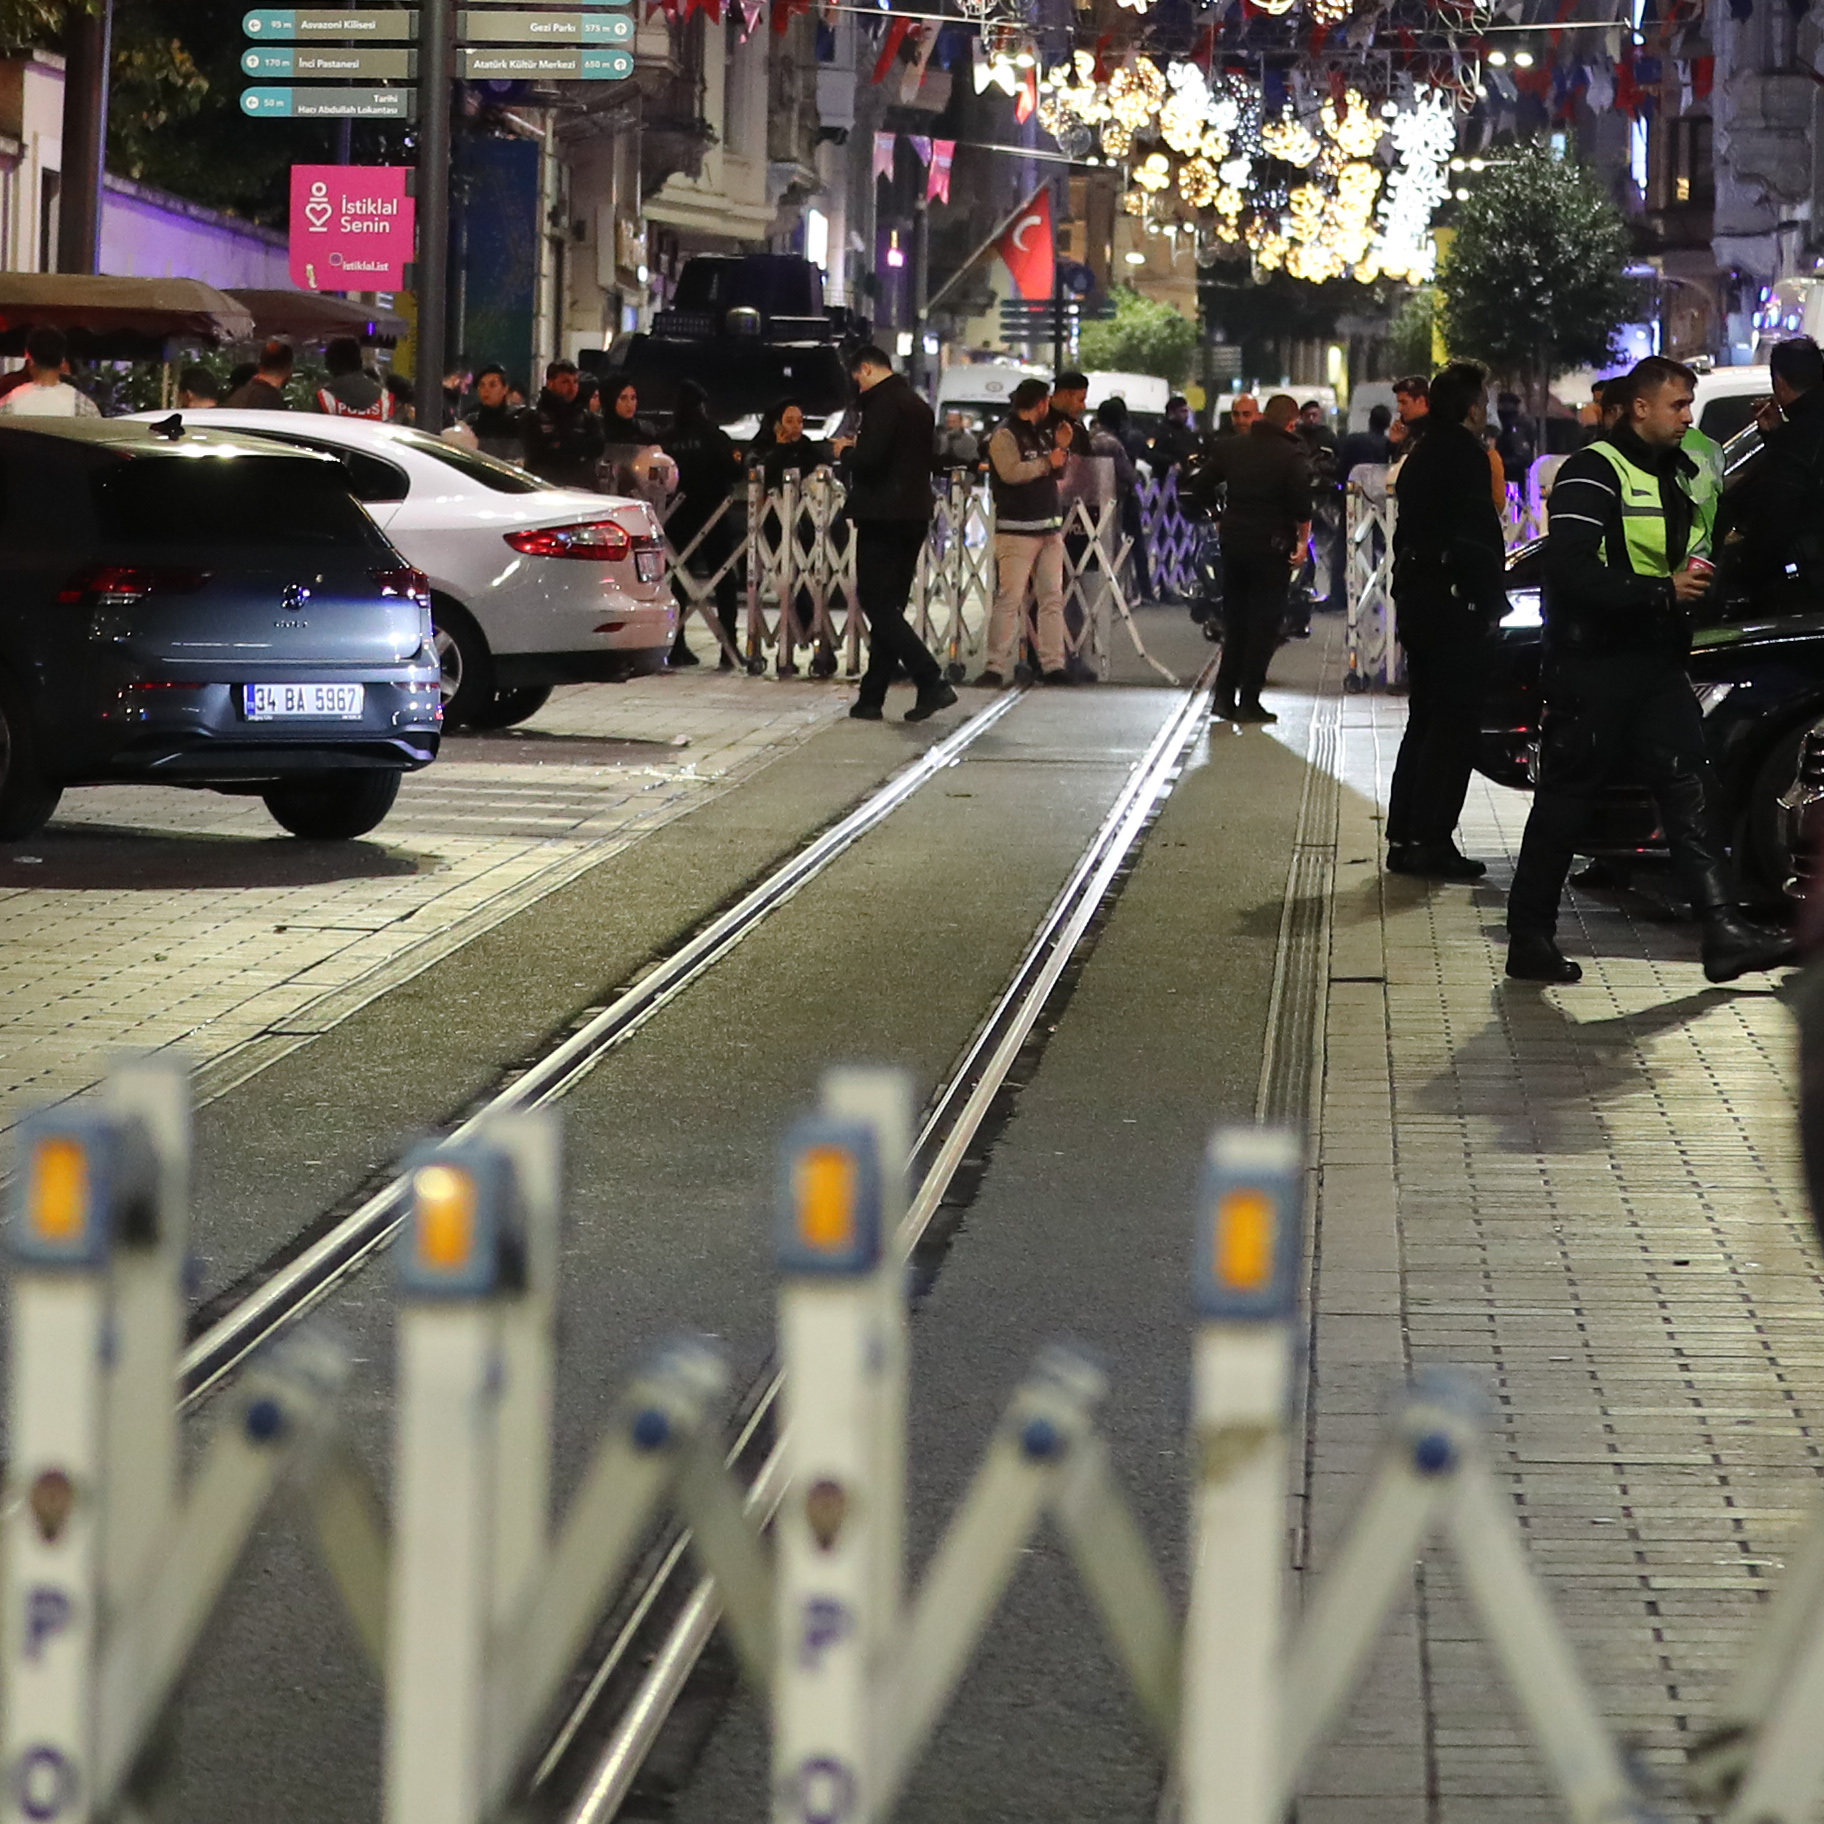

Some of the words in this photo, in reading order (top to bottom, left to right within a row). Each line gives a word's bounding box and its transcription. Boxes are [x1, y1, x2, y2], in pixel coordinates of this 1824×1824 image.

[344, 20, 376, 30] Kilisesi
[529, 22, 551, 32] Gezi
[552, 23, 576, 32] Parkı
[299, 57, 315, 68] İnci
[317, 59, 360, 69] Pastanesi
[473, 59, 508, 69] Atatürk
[509, 59, 537, 69] Kültür
[539, 59, 576, 69] Merkezi
[373, 94, 398, 103] Tarihi
[318, 106, 356, 114] Abdullah
[357, 106, 398, 115] Lokantası
[341, 194, 398, 215] İstiklal
[340, 217, 390, 233] Senin
[256, 688, 276, 711] 34
[285, 688, 306, 712] BA
[315, 688, 356, 712] 5967
